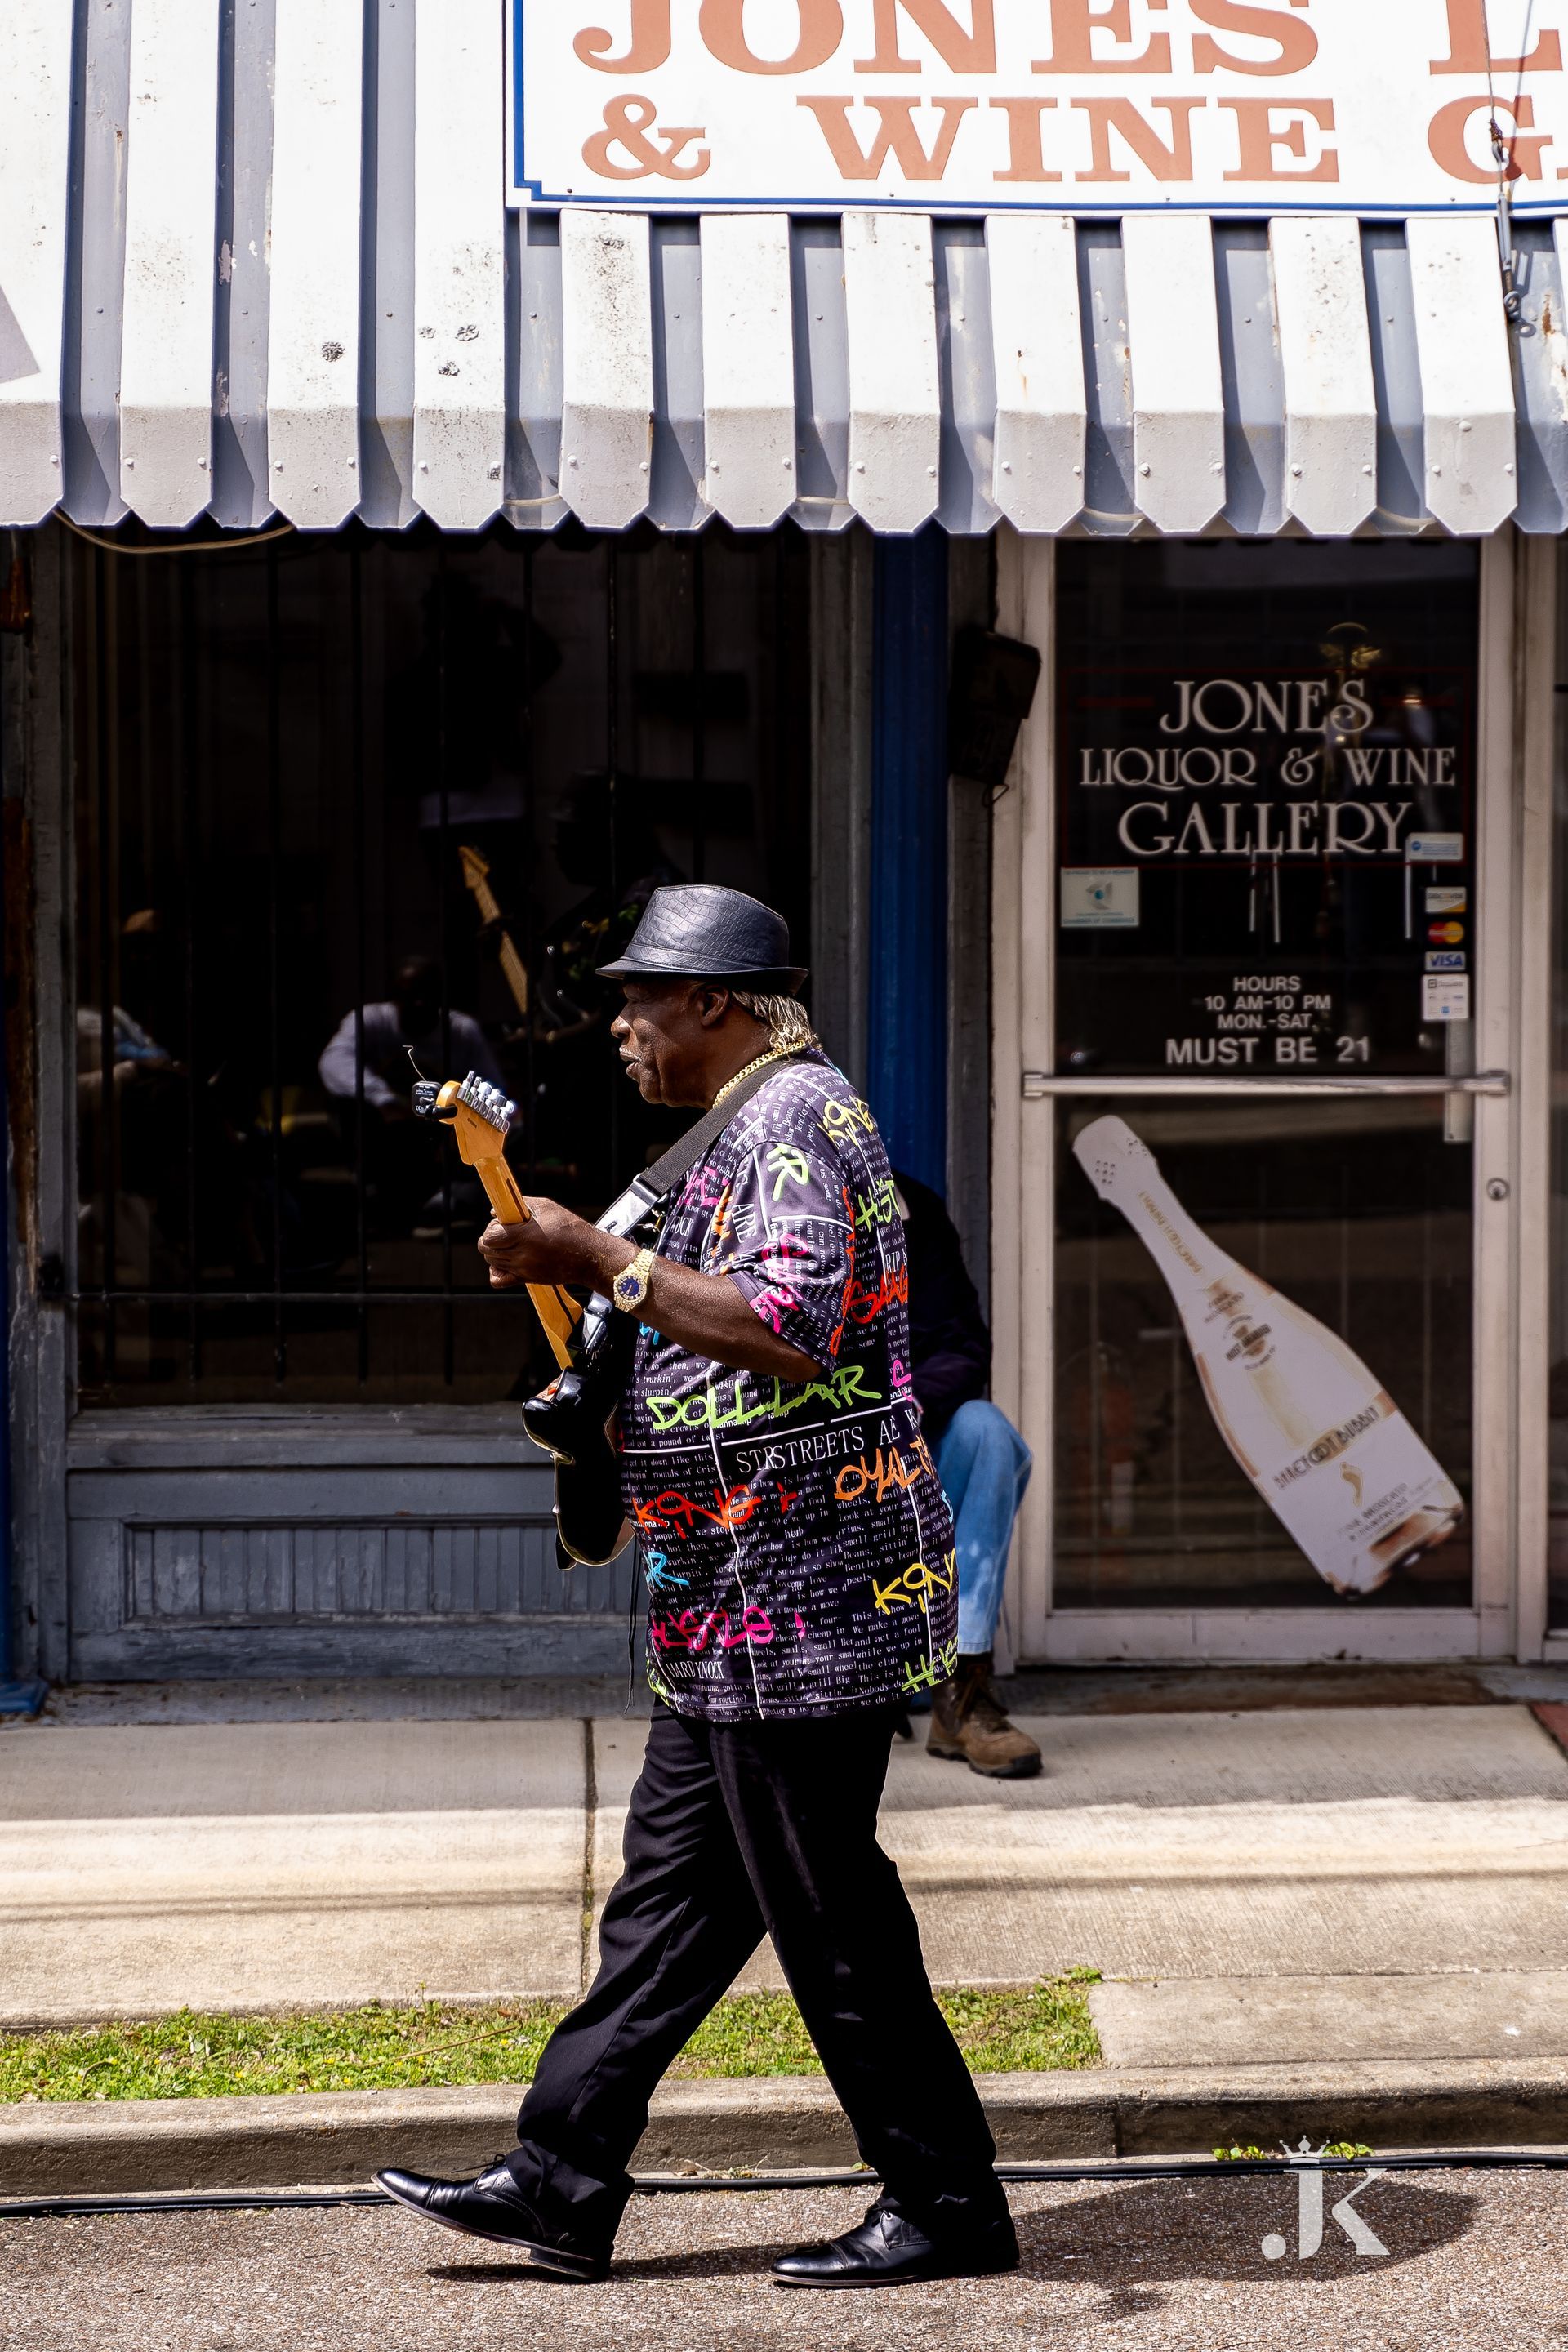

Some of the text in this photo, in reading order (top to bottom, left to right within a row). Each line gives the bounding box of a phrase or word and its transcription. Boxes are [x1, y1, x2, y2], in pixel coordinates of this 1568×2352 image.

[573, 0, 1319, 75] JONES
[582, 93, 711, 179] &
[796, 94, 1339, 182] WINE
[1160, 679, 1374, 733] JONES
[1080, 746, 1456, 791] LIQUOR & WINE
[1118, 800, 1414, 856] GALLERY
[1431, 954, 1463, 967] VISA
[1233, 976, 1300, 991] HOURS
[1205, 995, 1225, 1011] 10
[1303, 994, 1332, 1010] PM
[1166, 1036, 1370, 1065] MUST BE 21
[669, 1361, 706, 1371] then, we
[658, 1437, 682, 1448] pound
[671, 1455, 690, 1464] like
[694, 1453, 714, 1462] this
[653, 1468, 679, 1478] rounds
[805, 1485, 824, 1493] move
[808, 1494, 826, 1505] fool
[836, 1496, 871, 1510] wheels,
[805, 1508, 829, 1521] up in
[838, 1503, 899, 1523] Look at your
[840, 1515, 895, 1535] rims, small
[695, 1528, 706, 1536] we
[842, 1523, 915, 1548] small grill Big
[686, 1542, 710, 1552] then,
[770, 1542, 784, 1551] how
[804, 1538, 818, 1547] how
[879, 1535, 908, 1552] sittin'
[801, 1548, 825, 1561] do it
[844, 1548, 873, 1561] Beans,
[844, 1548, 919, 1573] Bentley my heart
[799, 1566, 808, 1575] it
[826, 1560, 844, 1568] show
[809, 1576, 828, 1585] love
[846, 1573, 873, 1587] peels
[809, 1588, 824, 1598] how
[827, 1586, 838, 1594] we
[820, 1600, 840, 1610] move
[890, 1604, 906, 1615] how
[851, 1611, 873, 1623] This
[853, 1625, 864, 1634] We
[867, 1621, 889, 1633] make
[901, 1613, 920, 1624] move
[807, 1629, 831, 1641] cheap
[835, 1625, 845, 1635] in
[854, 1636, 871, 1647] and
[875, 1633, 890, 1642] act
[904, 1624, 921, 1637] fool
[813, 1638, 836, 1651] small
[856, 1637, 924, 1659] while we up in
[814, 1653, 834, 1664] your
[858, 1655, 899, 1672] the club
[807, 1665, 830, 1677] small
[858, 1669, 894, 1684] This is
[808, 1677, 831, 1689] grill
[835, 1676, 851, 1685] Big
[859, 1692, 900, 1707] we do it
